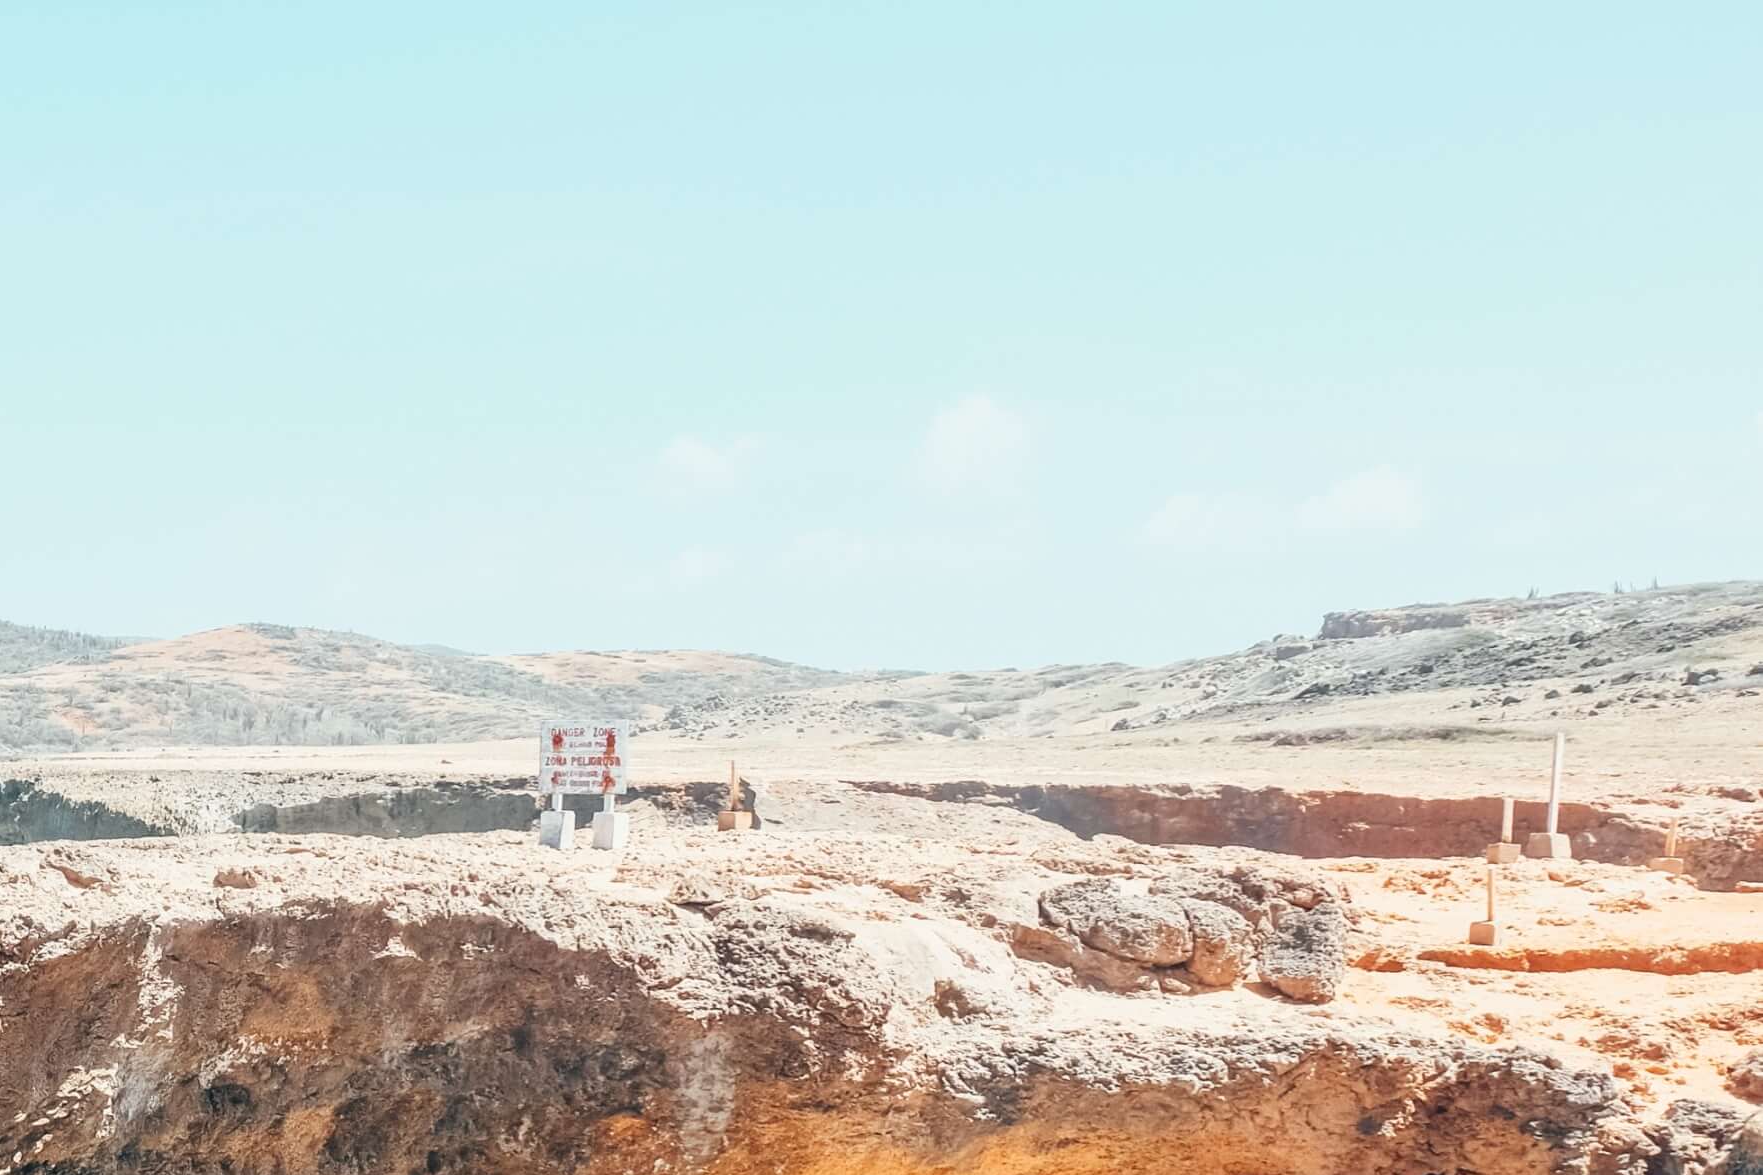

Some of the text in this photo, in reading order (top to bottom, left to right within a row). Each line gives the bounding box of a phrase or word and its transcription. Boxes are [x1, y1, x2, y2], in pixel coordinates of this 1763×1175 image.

[550, 727, 617, 738] DANGER ZONE
[545, 756, 621, 767] ZONA PELIGROSA
